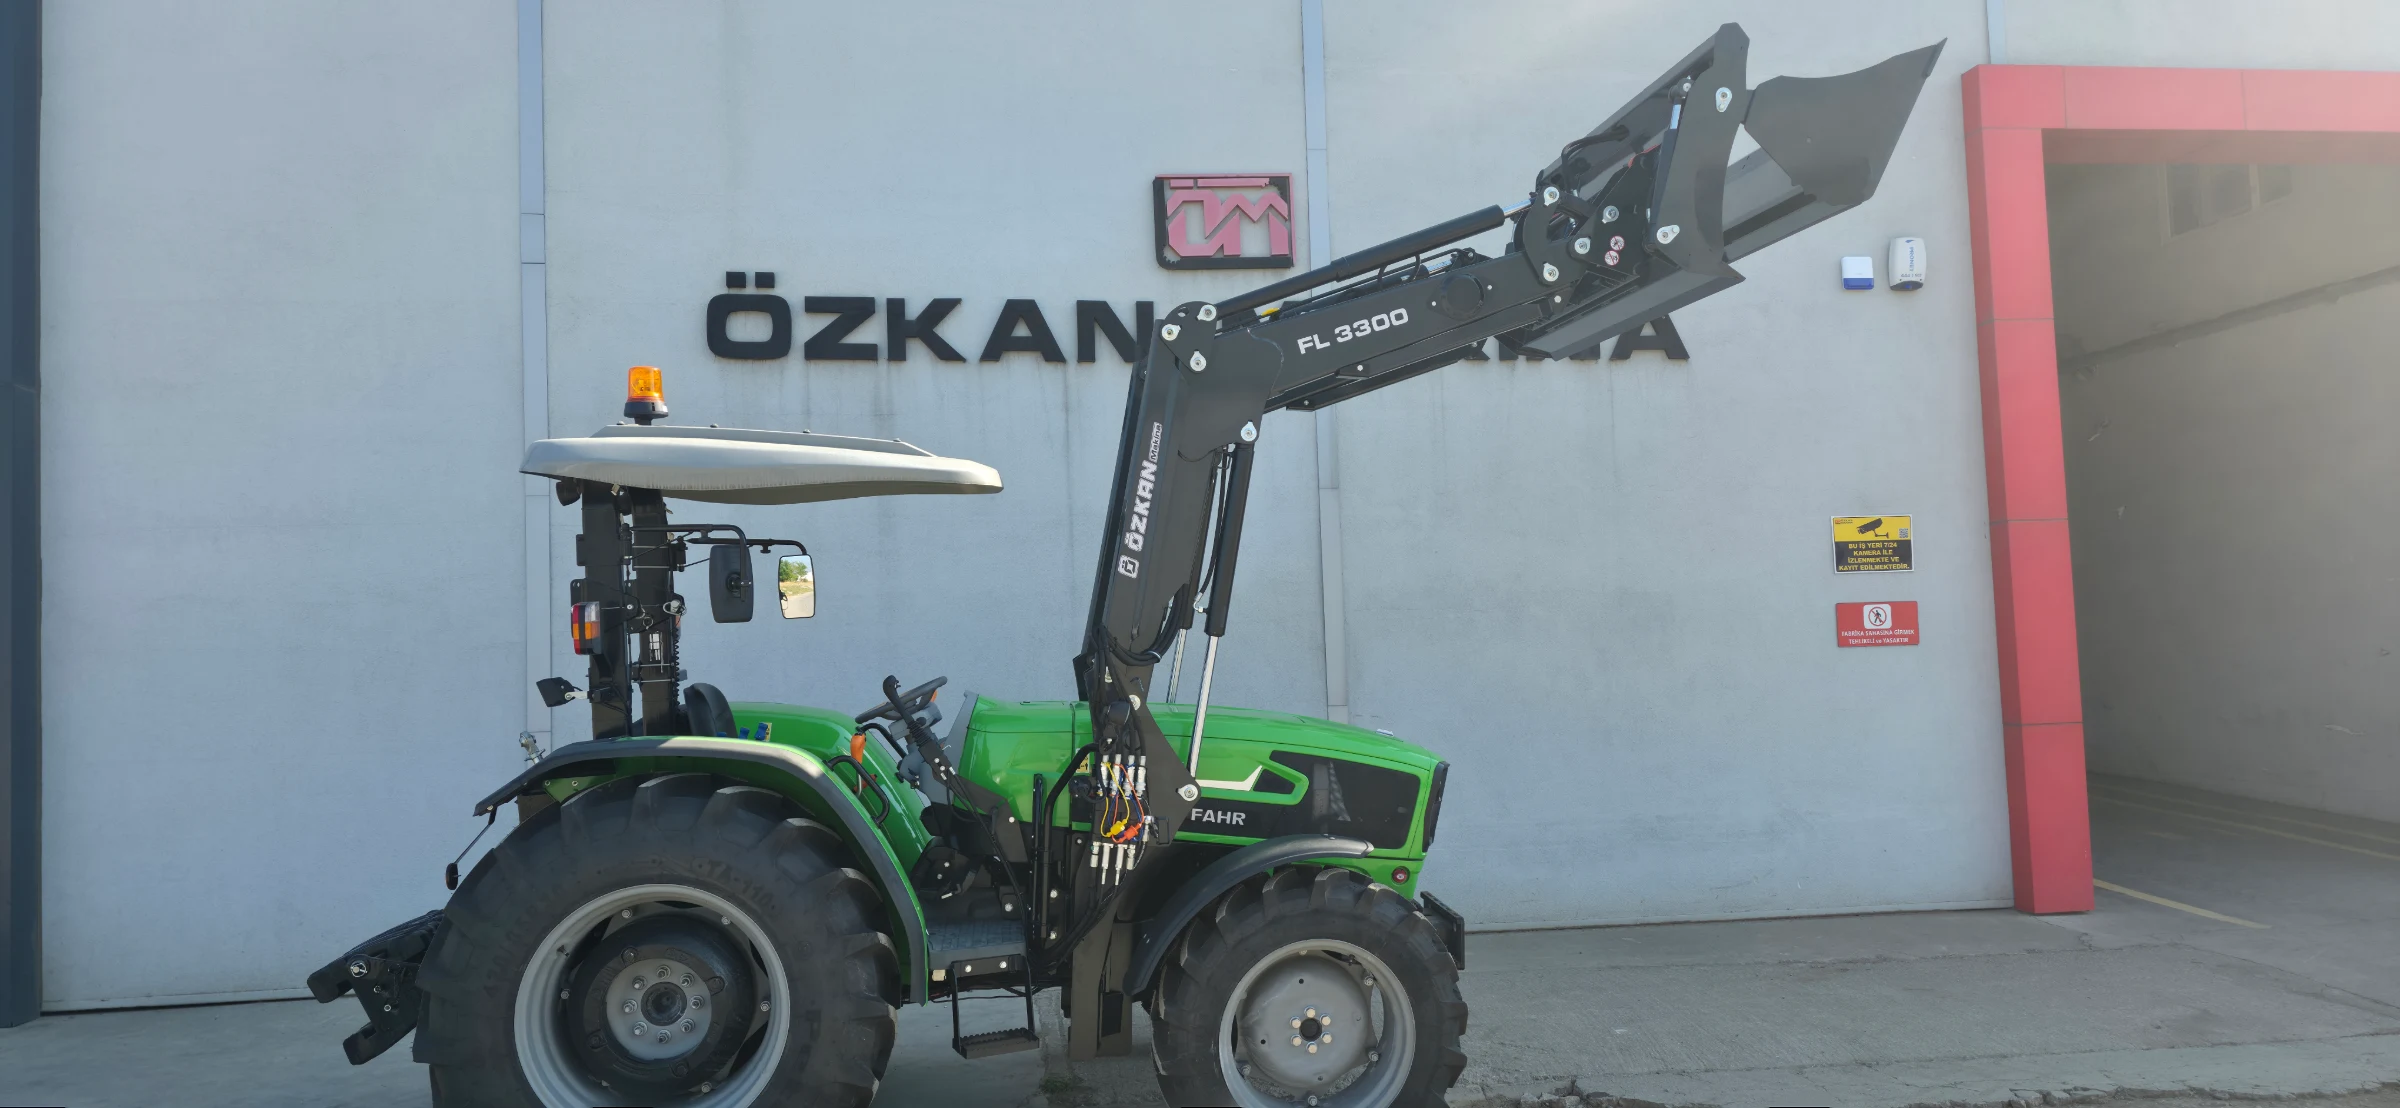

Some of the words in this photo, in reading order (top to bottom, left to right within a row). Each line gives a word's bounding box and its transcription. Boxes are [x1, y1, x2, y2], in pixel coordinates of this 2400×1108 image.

[706, 271, 1154, 363] ÖZKAN
[1297, 333, 1331, 354] FL
[1334, 308, 1409, 343] 3300
[1125, 459, 1158, 551] ÖZKAN
[1149, 422, 1162, 461] Makina
[1191, 808, 1246, 826] FAHR
